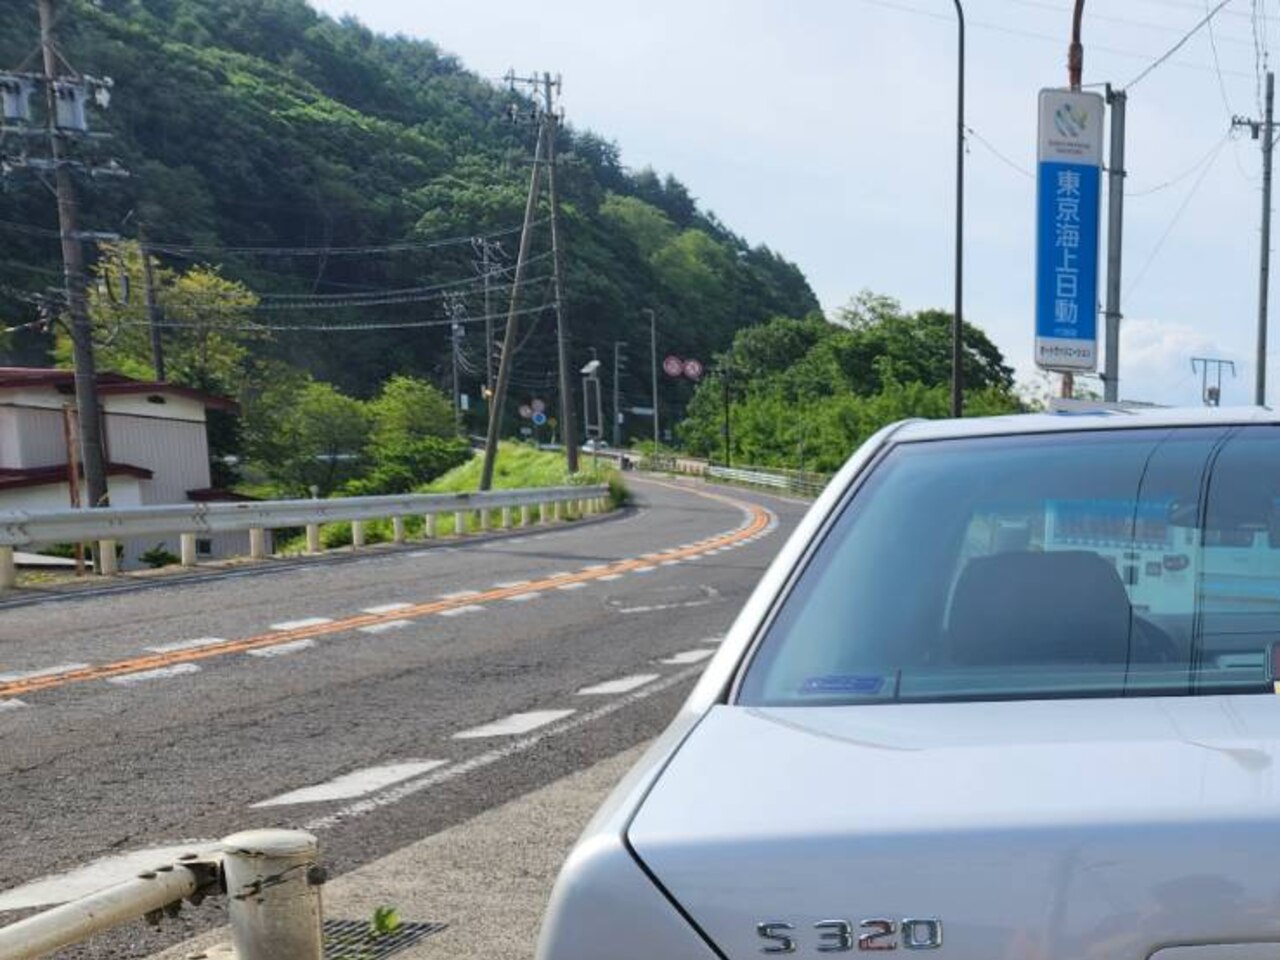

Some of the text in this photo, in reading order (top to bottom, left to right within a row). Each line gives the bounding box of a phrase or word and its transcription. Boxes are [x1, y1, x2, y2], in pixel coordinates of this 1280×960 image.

[1055, 170, 1081, 324] 東京海上日動
[757, 918, 944, 953] S 320
